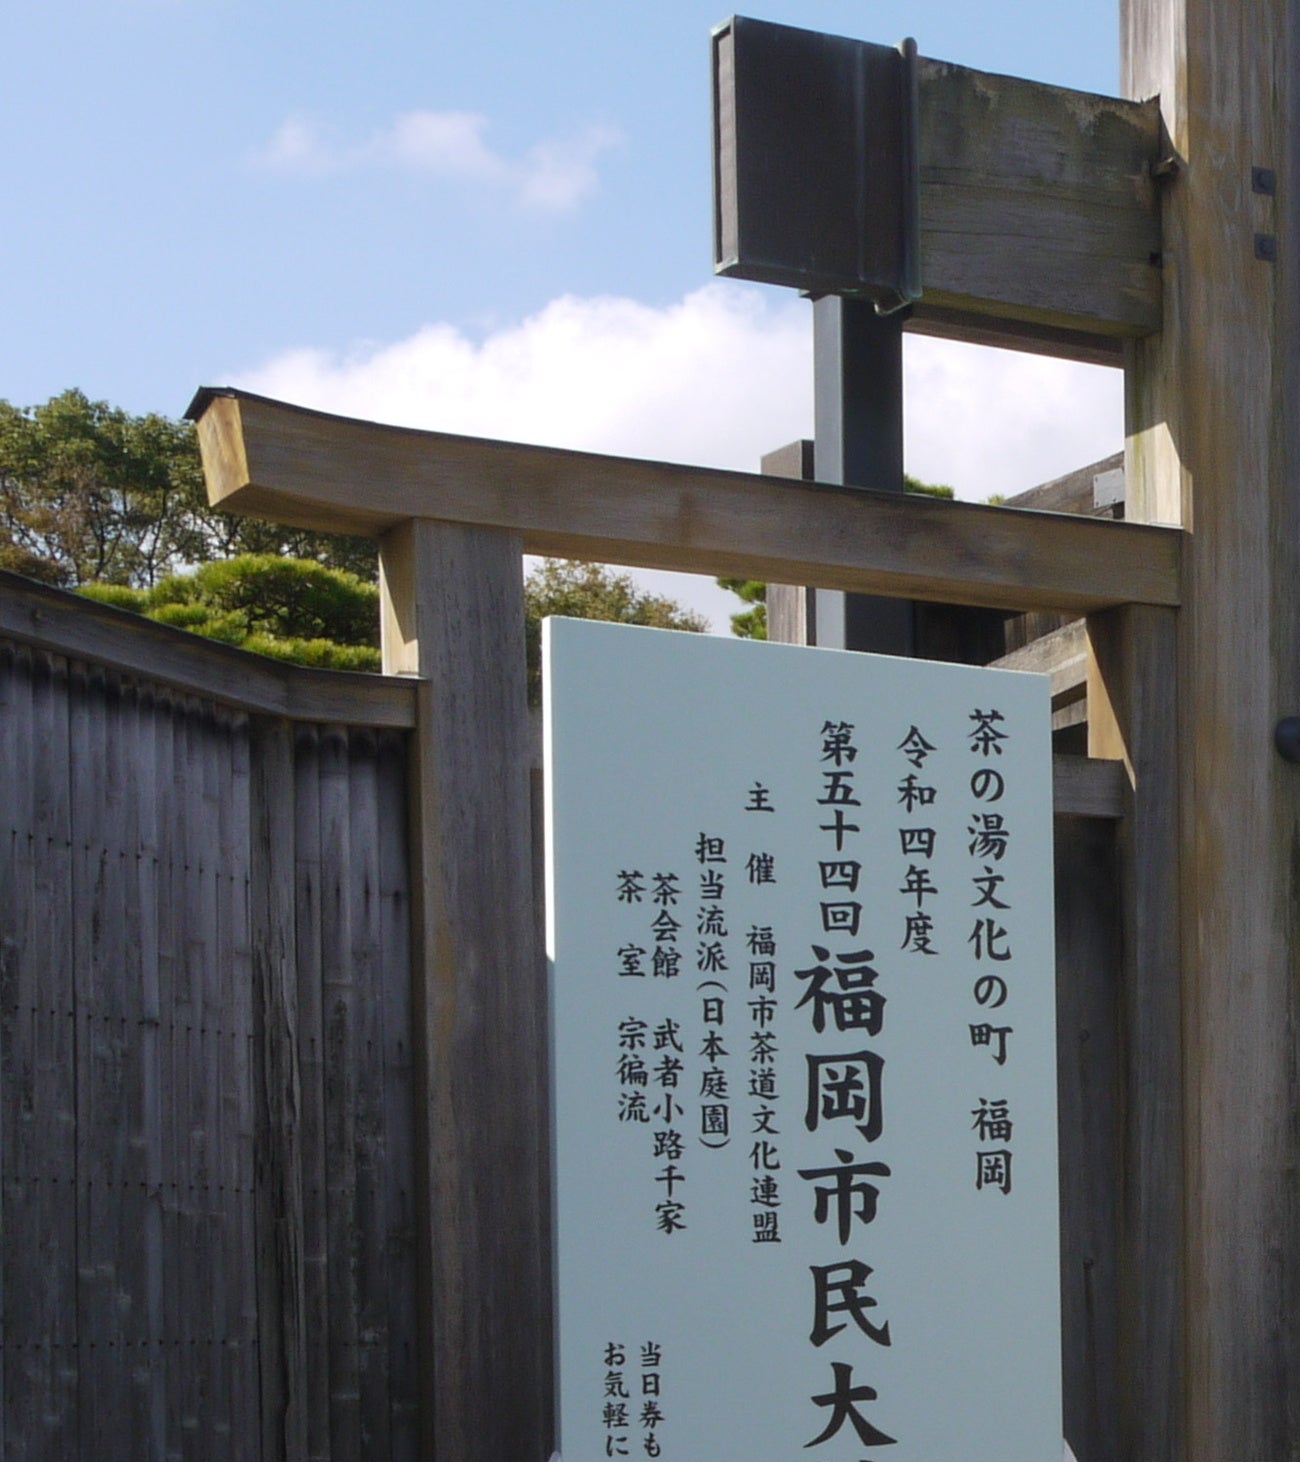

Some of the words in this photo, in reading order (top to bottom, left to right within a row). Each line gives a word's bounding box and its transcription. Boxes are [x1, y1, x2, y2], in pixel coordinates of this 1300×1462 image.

[650, 871, 684, 980] 茶会館
[895, 724, 939, 956] 令和四年度
[967, 707, 1014, 1067] 茶の湯文化の町
[652, 1016, 687, 1236] 武者小路千家
[745, 924, 783, 1244] 福岡市茶道文化連盟
[970, 1096, 1014, 1197] 福岡
